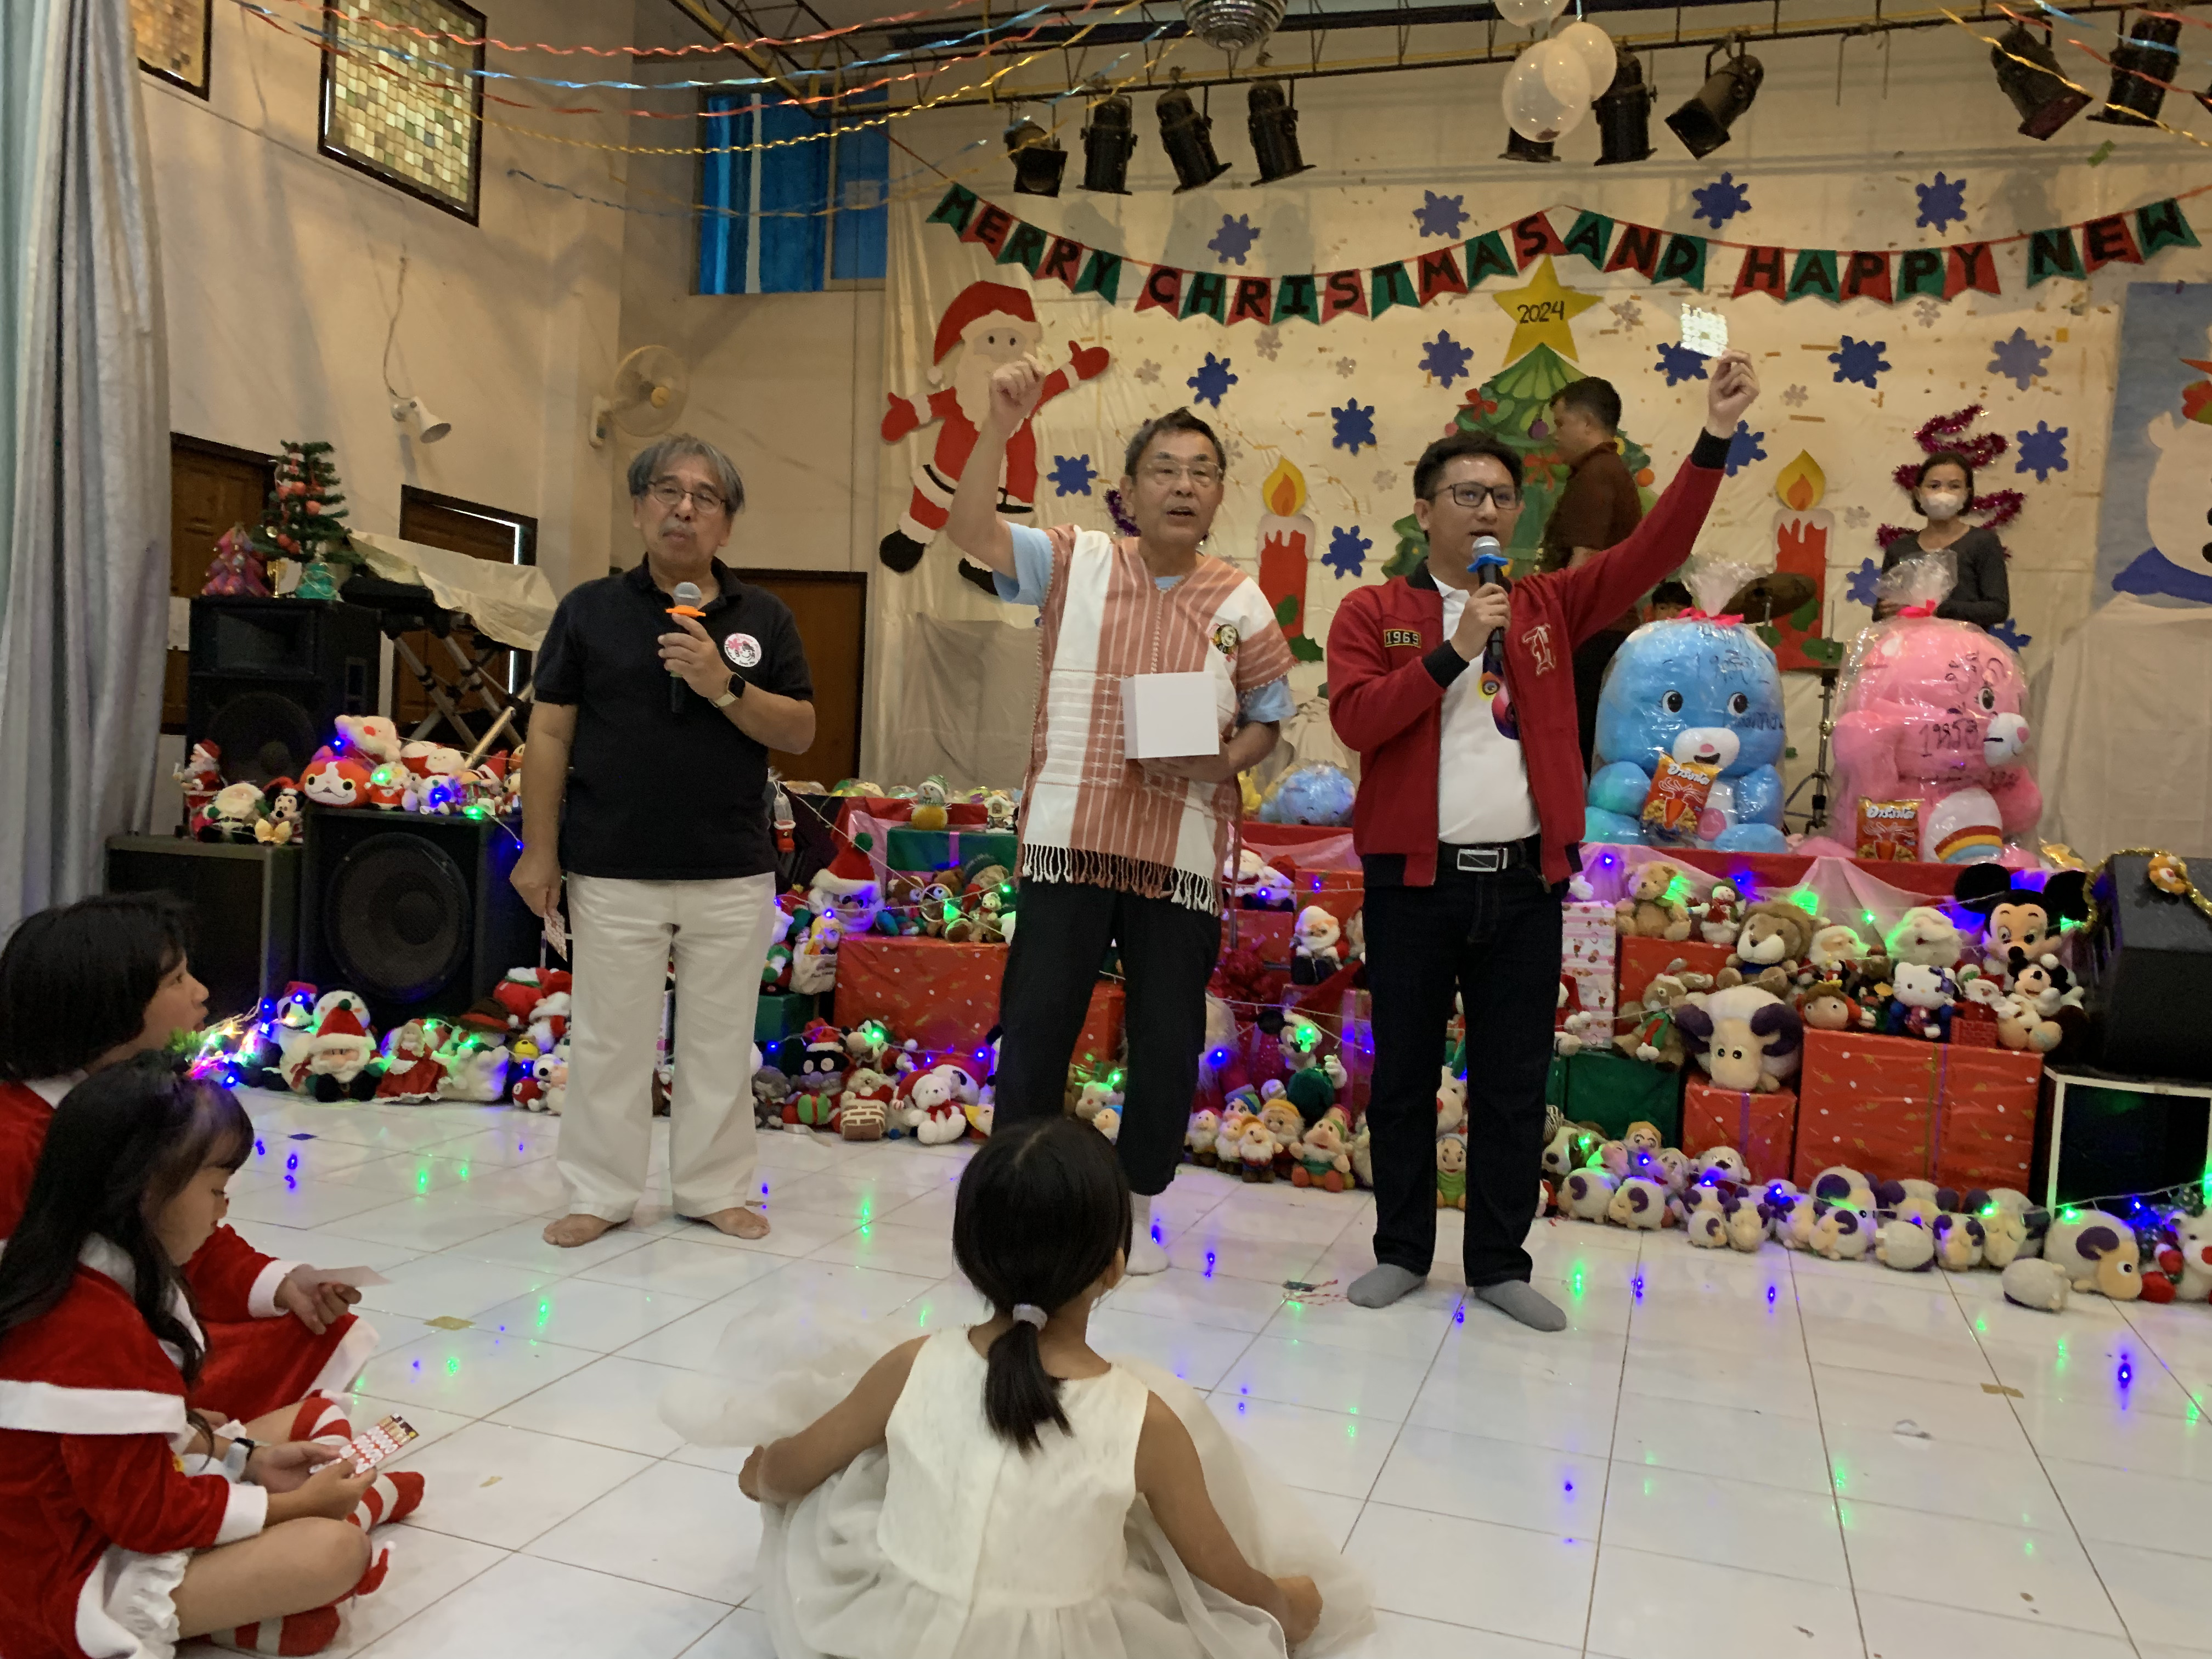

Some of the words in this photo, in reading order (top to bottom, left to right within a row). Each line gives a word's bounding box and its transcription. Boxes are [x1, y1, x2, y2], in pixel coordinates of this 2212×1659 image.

[934, 188, 1121, 292] MERRY
[1148, 215, 1549, 317] CHRISTMAS
[1566, 221, 1699, 275] AND
[1746, 242, 1987, 295] HAPPY
[2032, 201, 2186, 274] NEW
[1516, 300, 1565, 325] 2024
[1386, 631, 1419, 646] 1969
